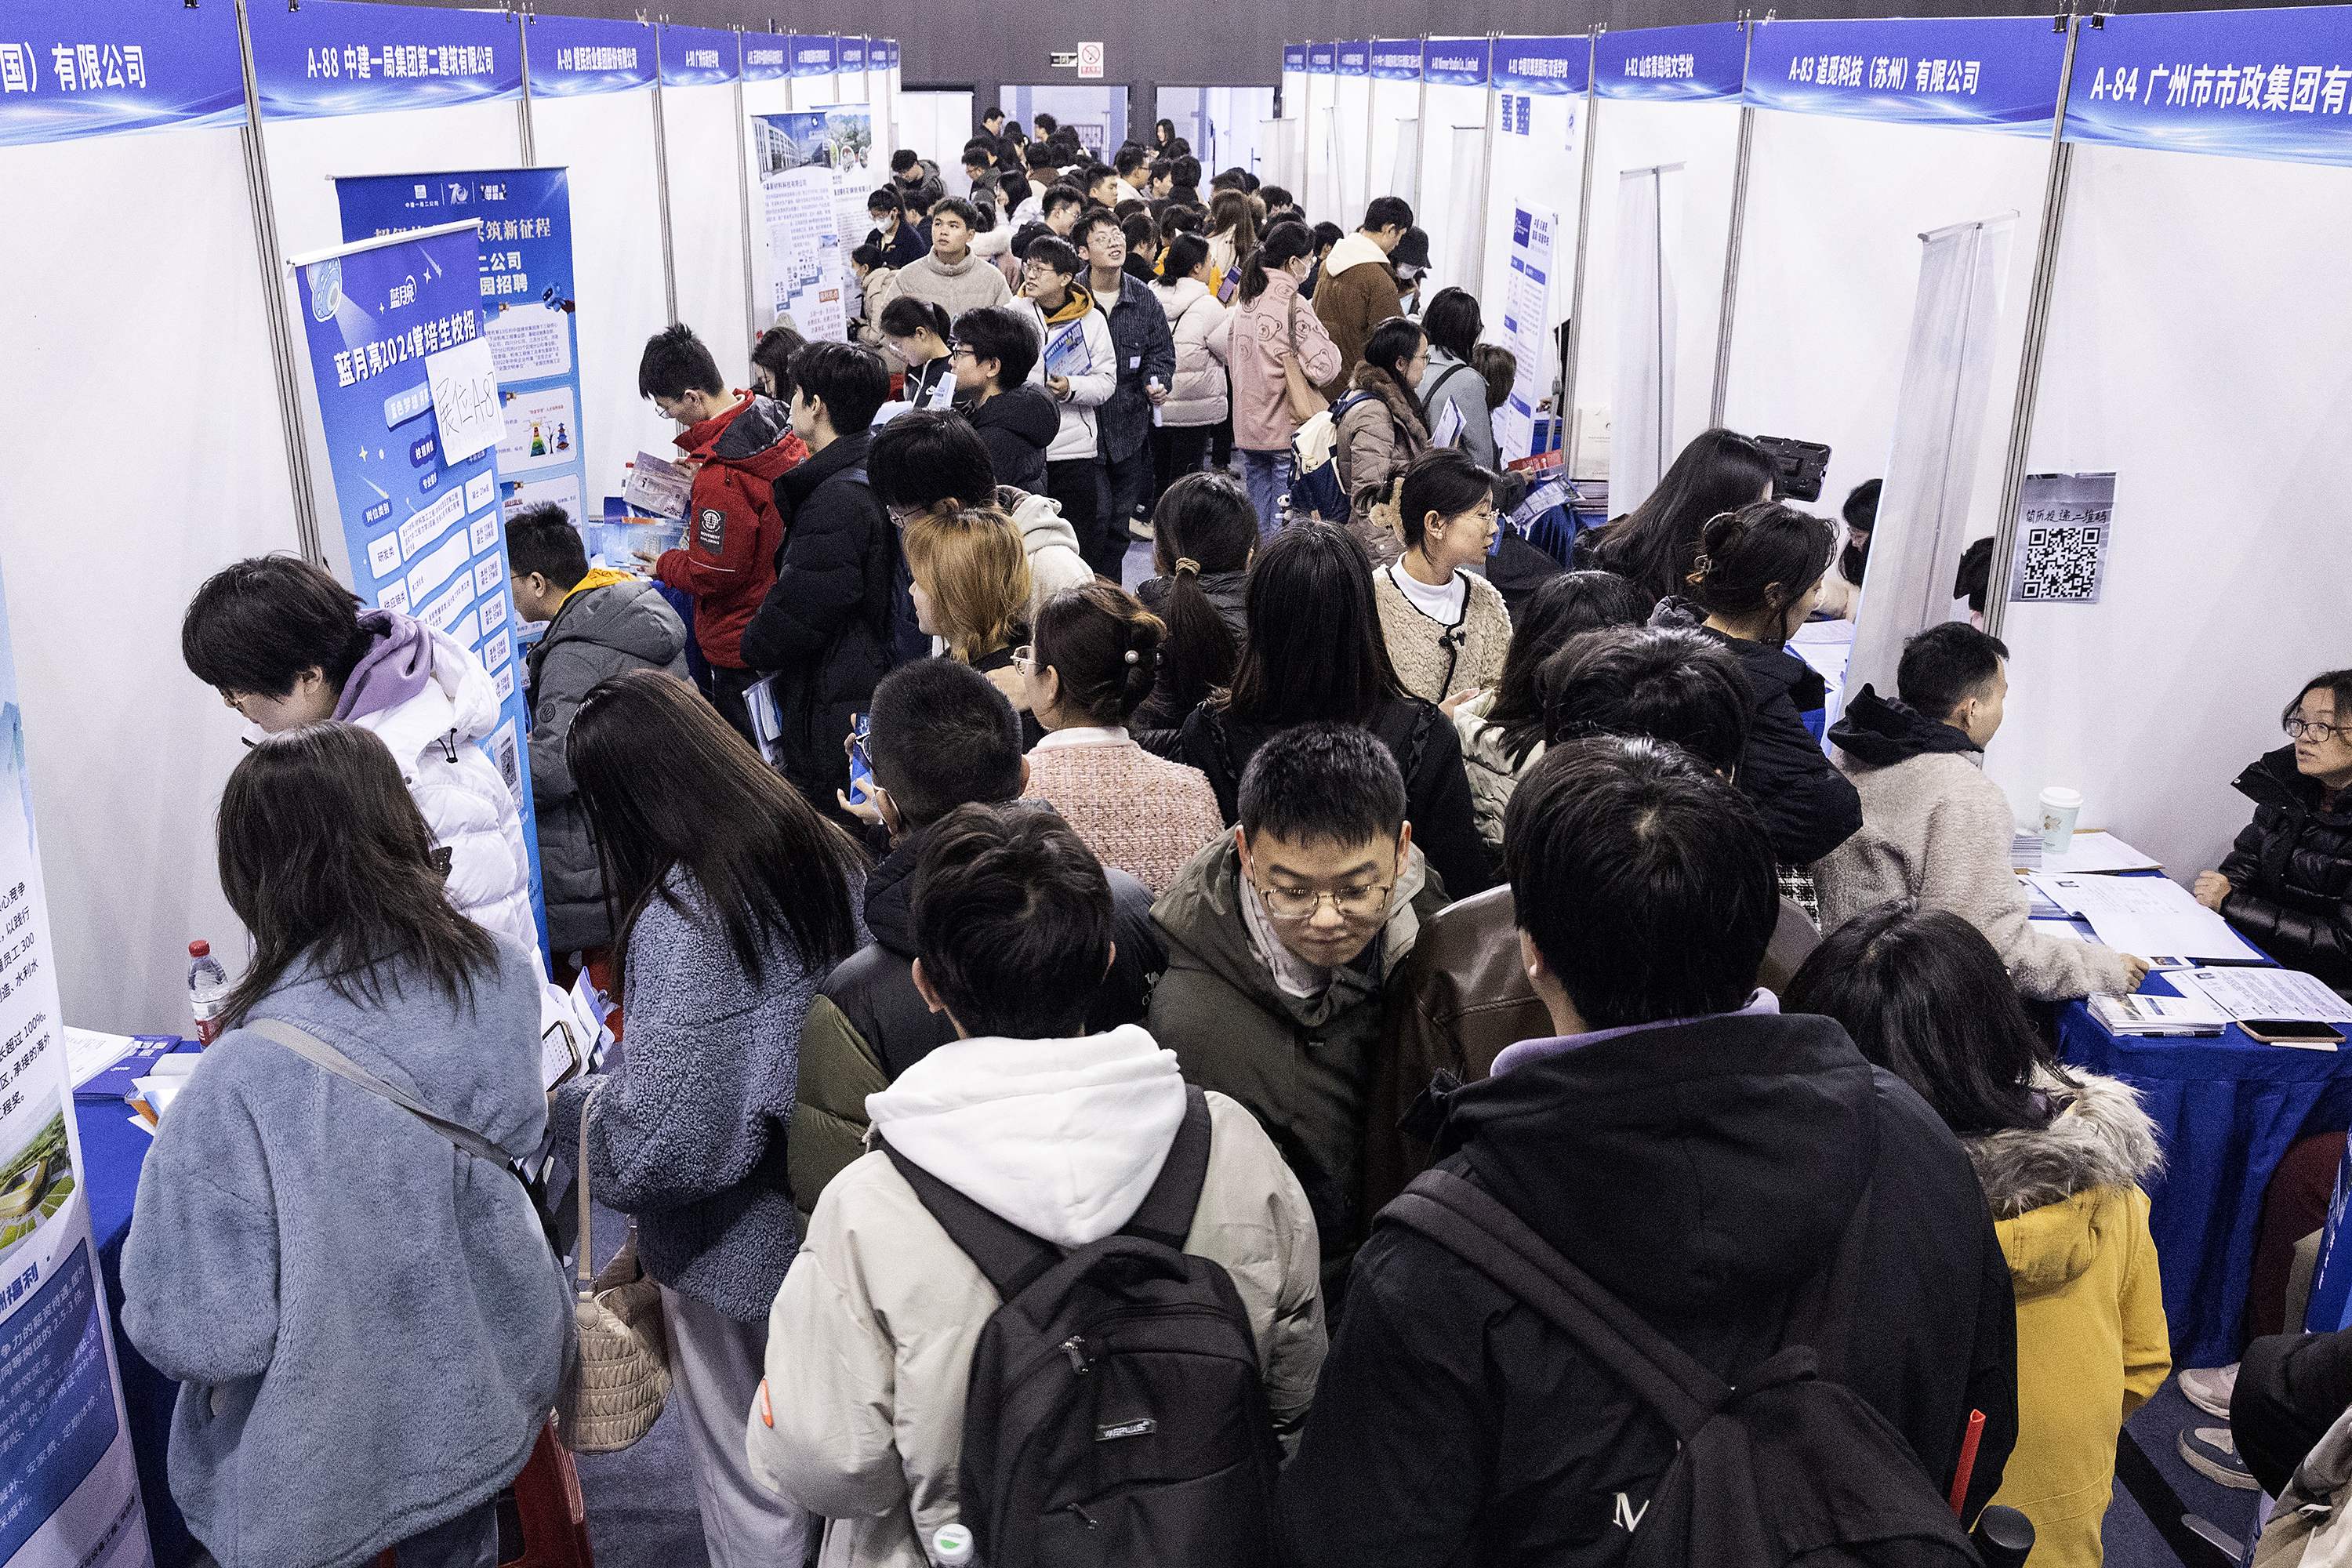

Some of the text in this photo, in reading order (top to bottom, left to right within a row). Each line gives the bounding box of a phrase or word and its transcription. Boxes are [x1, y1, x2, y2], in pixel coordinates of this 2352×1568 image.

[307, 44, 494, 79] A-88 中建一局集团第二建筑有限公司
[1788, 56, 1814, 82] A-83
[2090, 63, 2352, 115] A-84 广州市市政集团有
[389, 276, 417, 309] 蓝月亮
[333, 309, 476, 388] 蓝月亮2024管培生校招
[365, 502, 390, 523] 岗位类别
[377, 546, 395, 562] 研发类
[20, 931, 35, 953] 300
